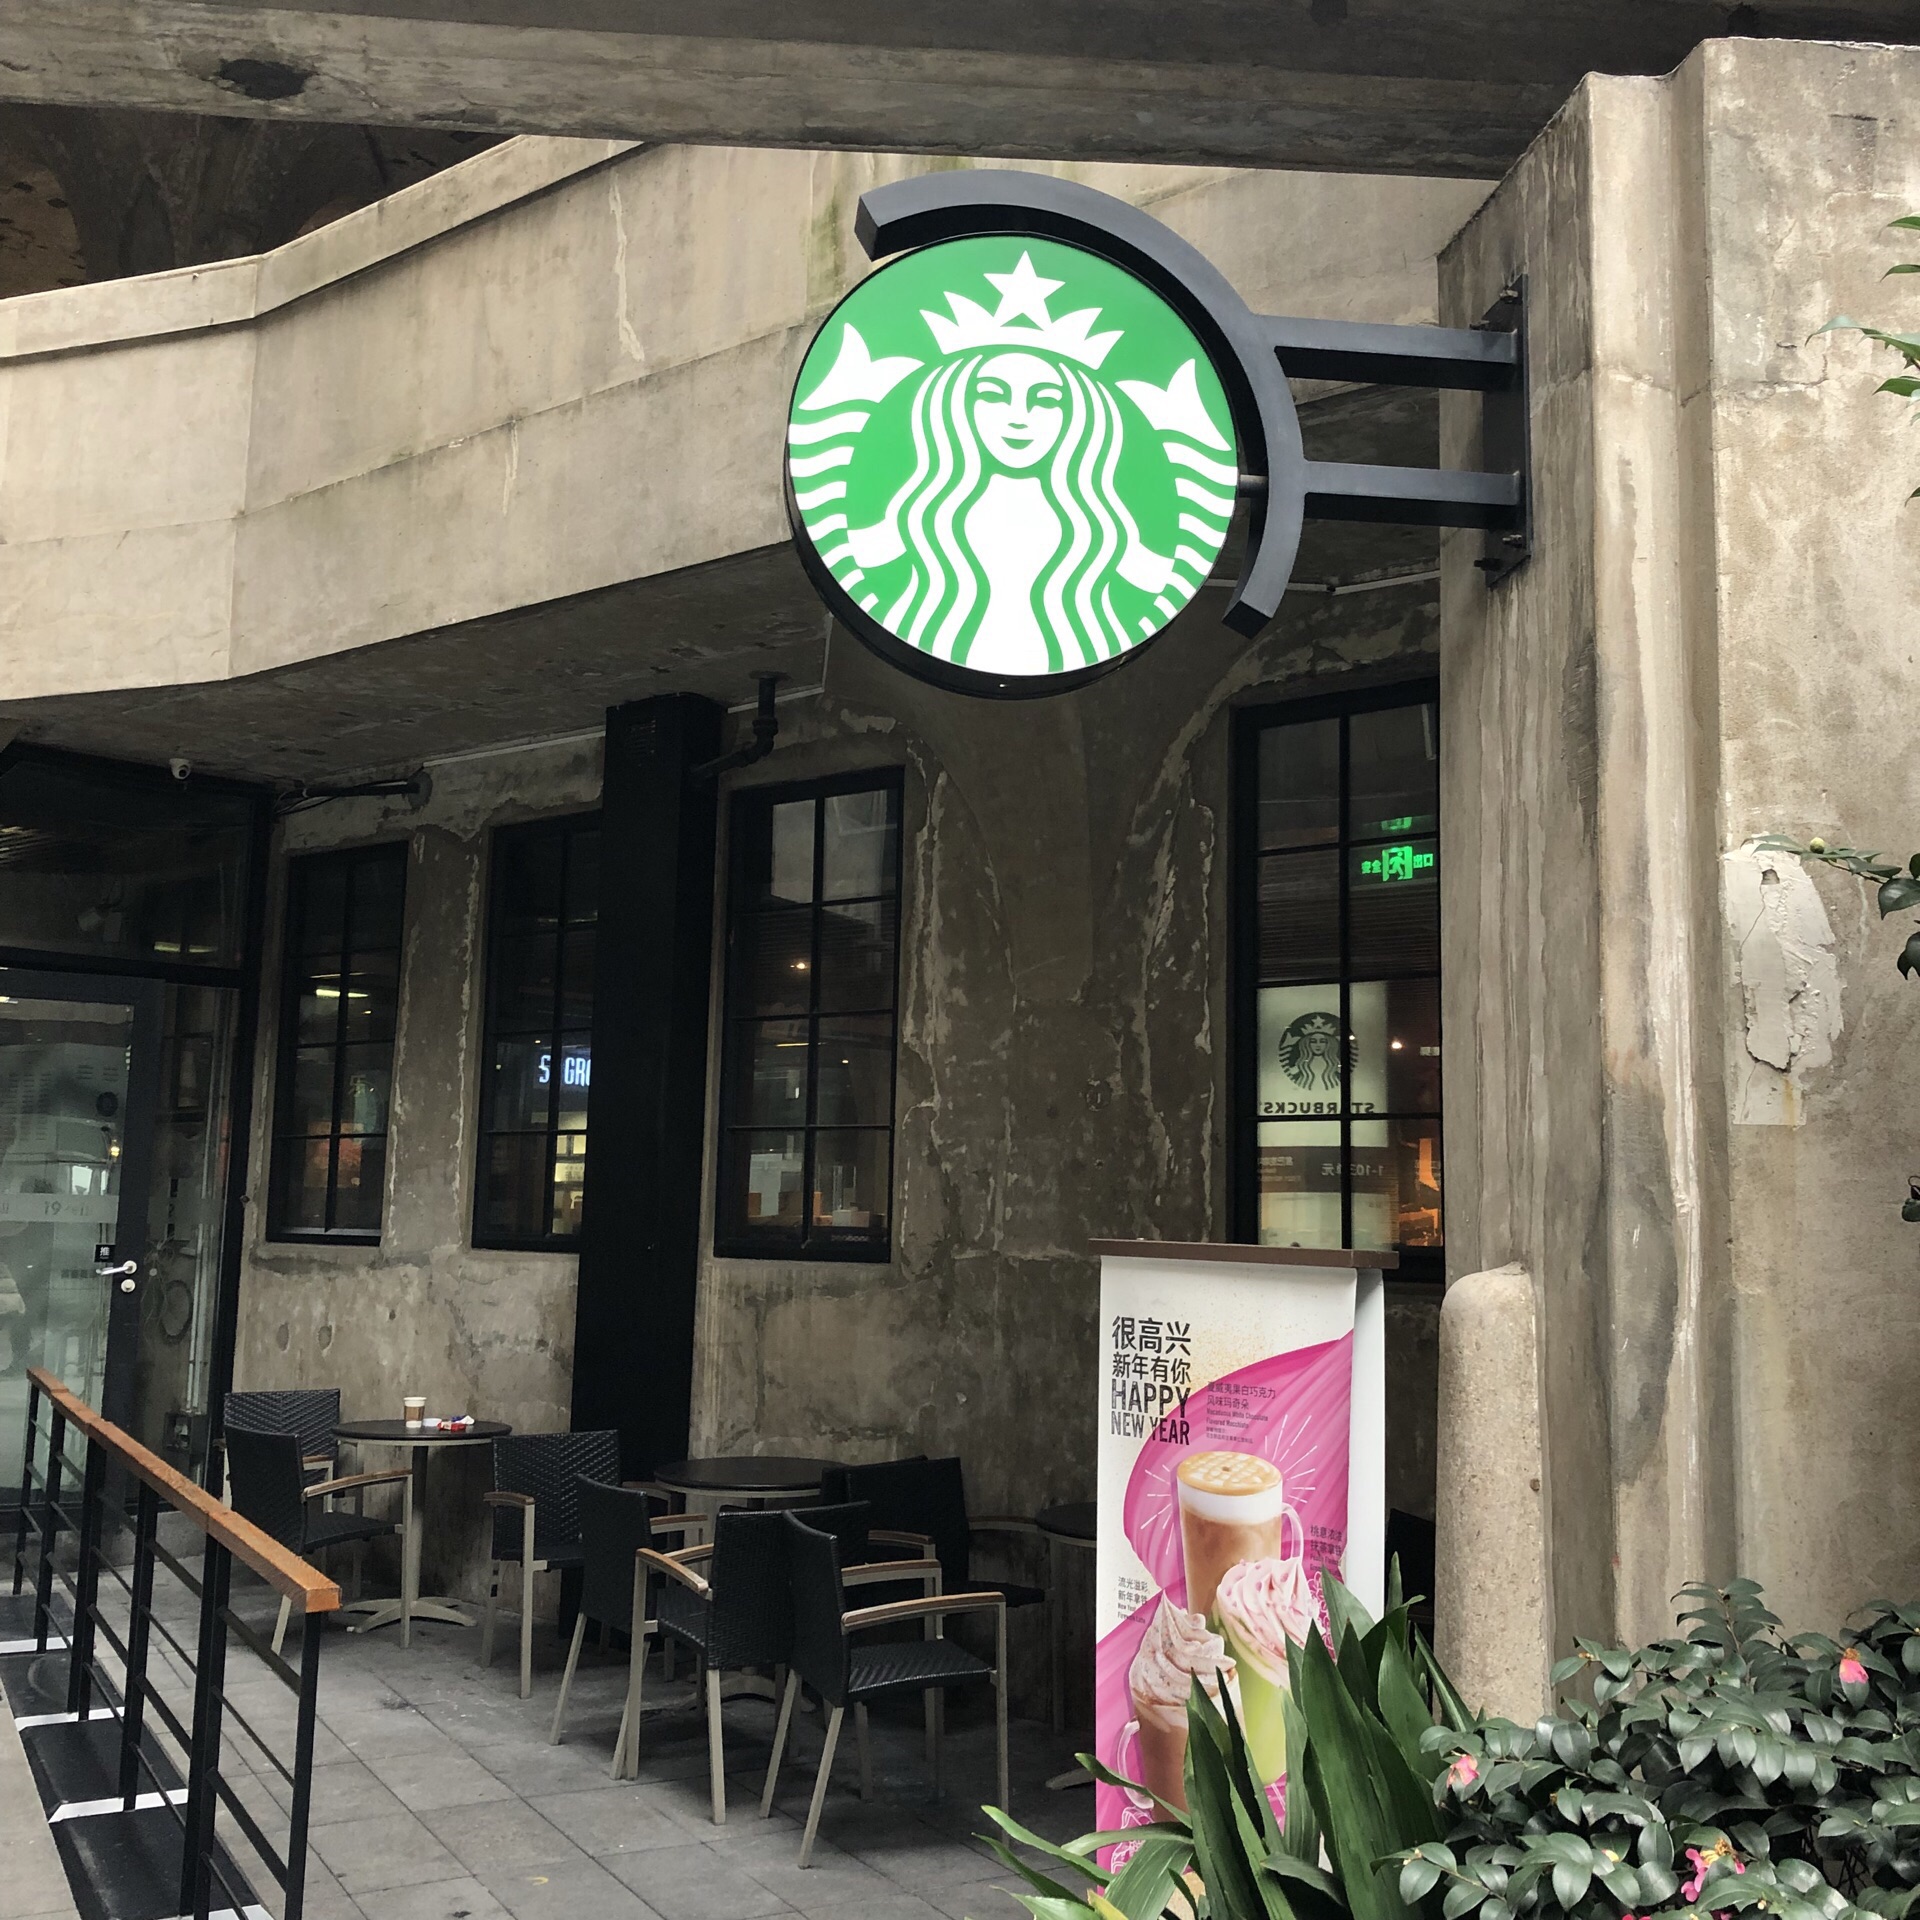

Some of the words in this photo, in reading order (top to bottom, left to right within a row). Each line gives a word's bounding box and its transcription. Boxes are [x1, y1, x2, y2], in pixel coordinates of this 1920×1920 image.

[1413, 853, 1434, 869] 出口
[1112, 1315, 1191, 1356] 很高兴
[1112, 1351, 1191, 1384] 新年有你
[1111, 1378, 1191, 1418] HAPPY
[1206, 1394, 1249, 1410] 风味玛奇朵
[1207, 1382, 1276, 1399] 夏威夷果白巧克力
[1111, 1411, 1145, 1438] NEW
[1149, 1416, 1190, 1445] YEAR
[1118, 1576, 1148, 1592] 流光溢彩
